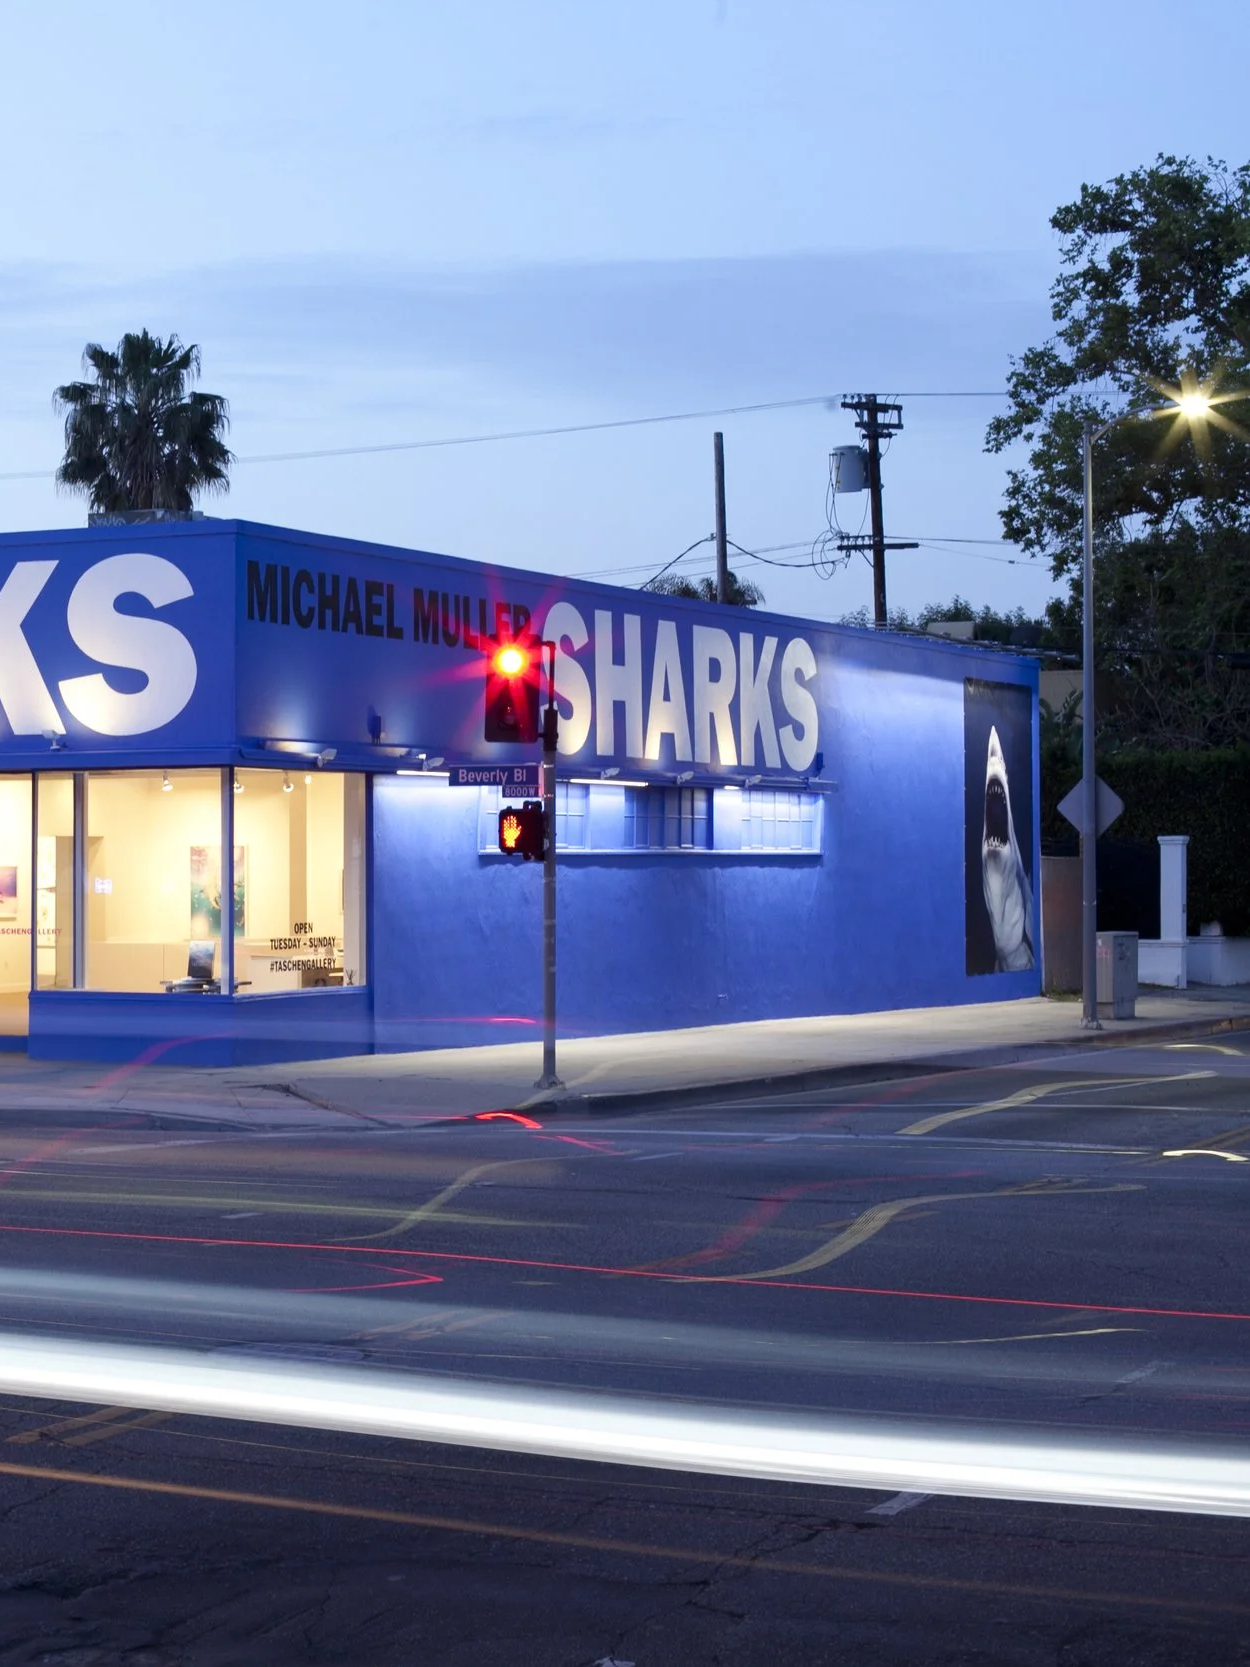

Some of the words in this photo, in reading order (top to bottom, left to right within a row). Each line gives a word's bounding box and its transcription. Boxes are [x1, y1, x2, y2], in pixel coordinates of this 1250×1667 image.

[246, 560, 404, 640] MICHAEL
[539, 601, 819, 772] SHARKS
[458, 768, 508, 785] Beverly
[513, 768, 527, 782] Bl
[294, 922, 313, 934] OPEN
[270, 938, 301, 950] TUESDAY
[308, 936, 336, 948] SUNDAY
[270, 957, 337, 972] #TASCHENGALLERY
